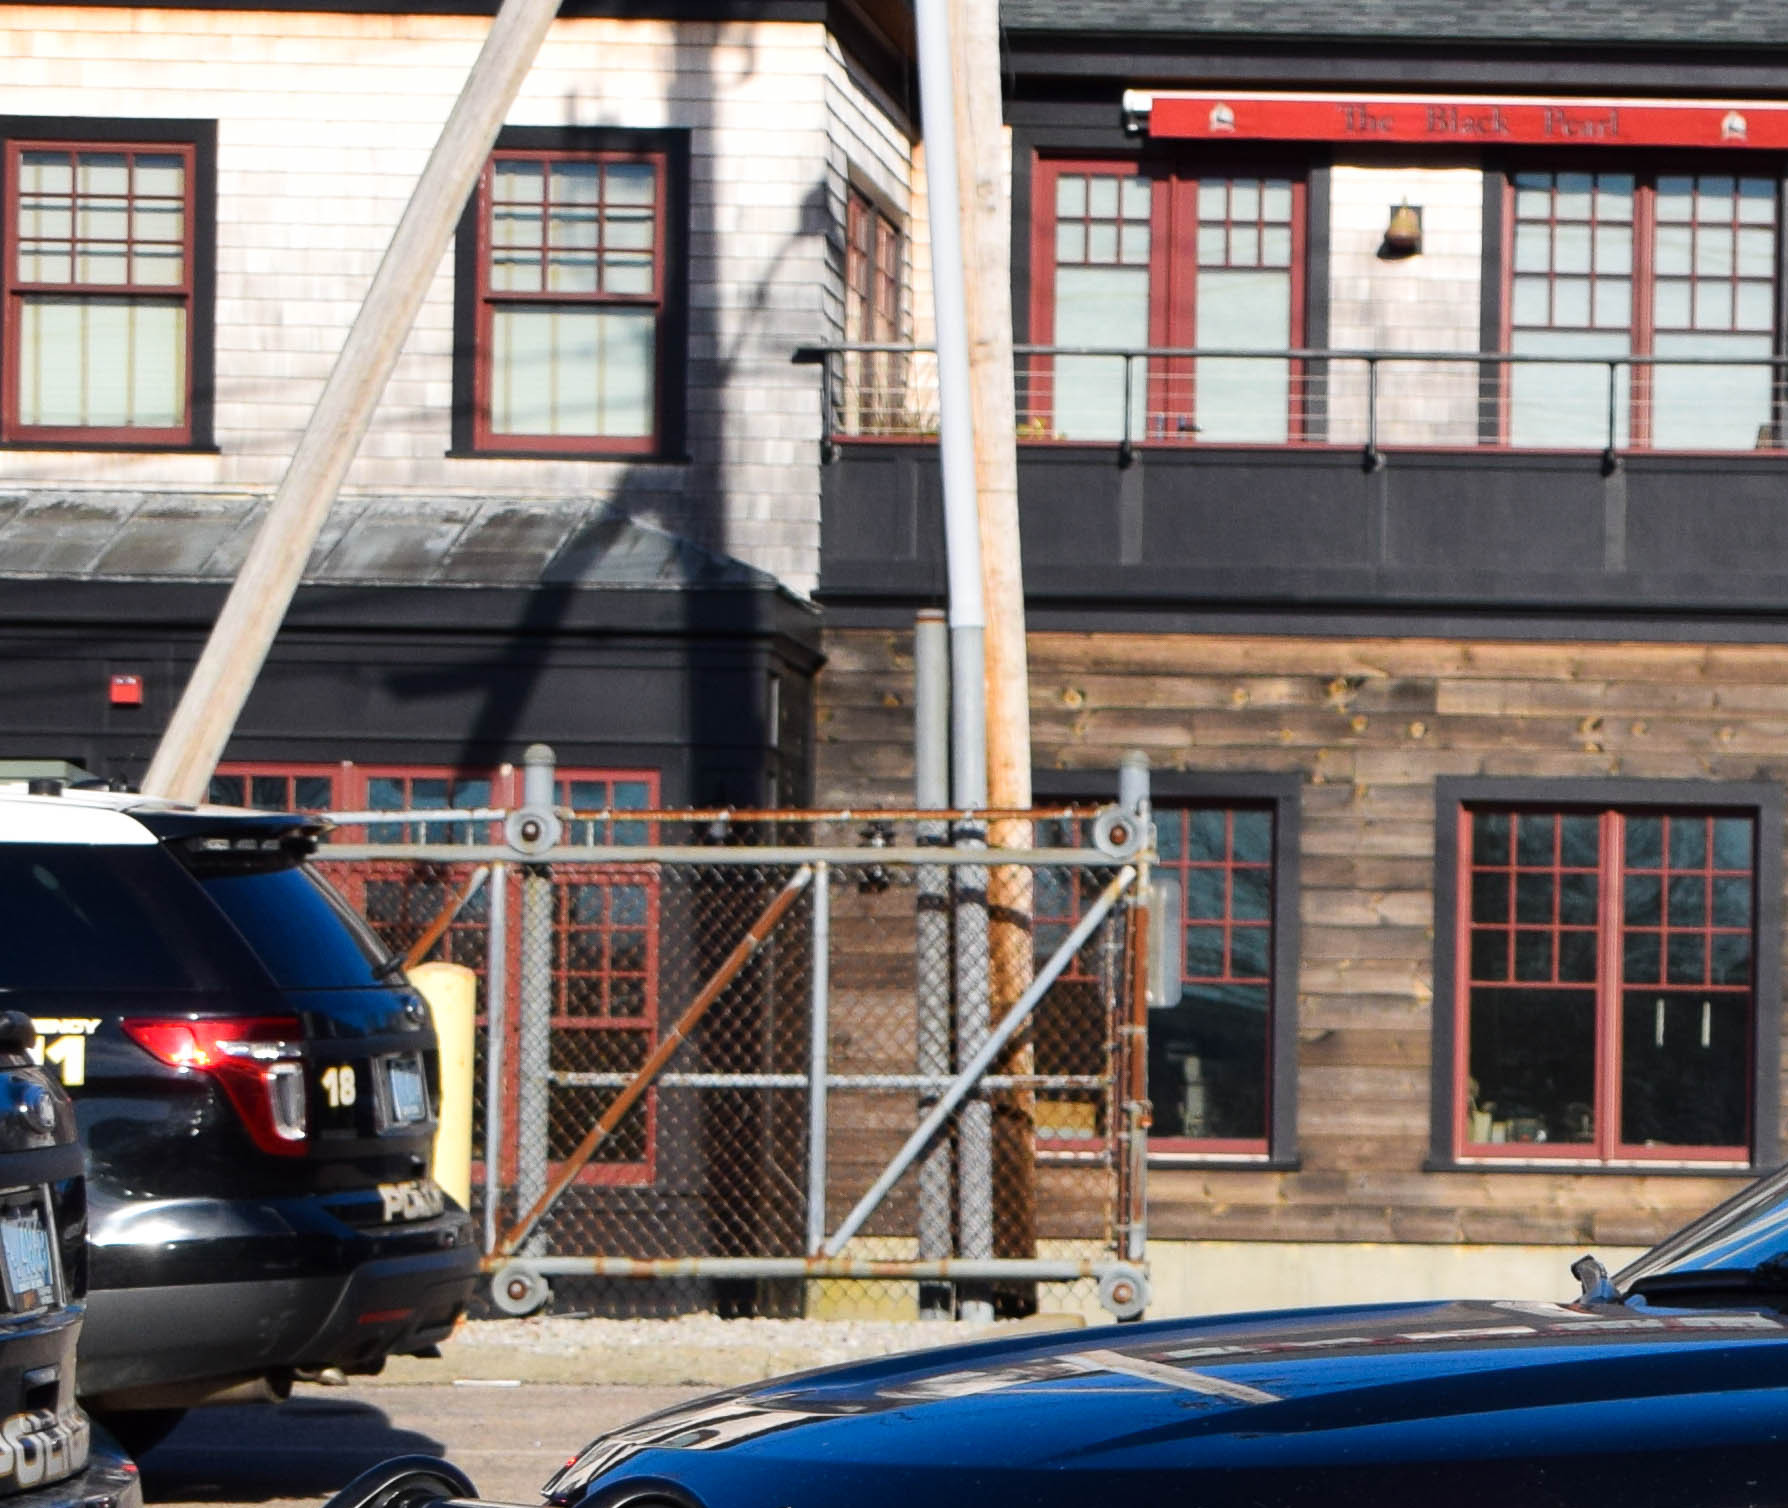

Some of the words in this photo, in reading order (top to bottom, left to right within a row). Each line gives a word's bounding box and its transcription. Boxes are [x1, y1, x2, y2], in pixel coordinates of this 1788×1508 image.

[1336, 103, 1392, 132] The
[1425, 105, 1509, 135] Black
[1543, 107, 1619, 137] Pearl
[321, 1065, 357, 1107] 18
